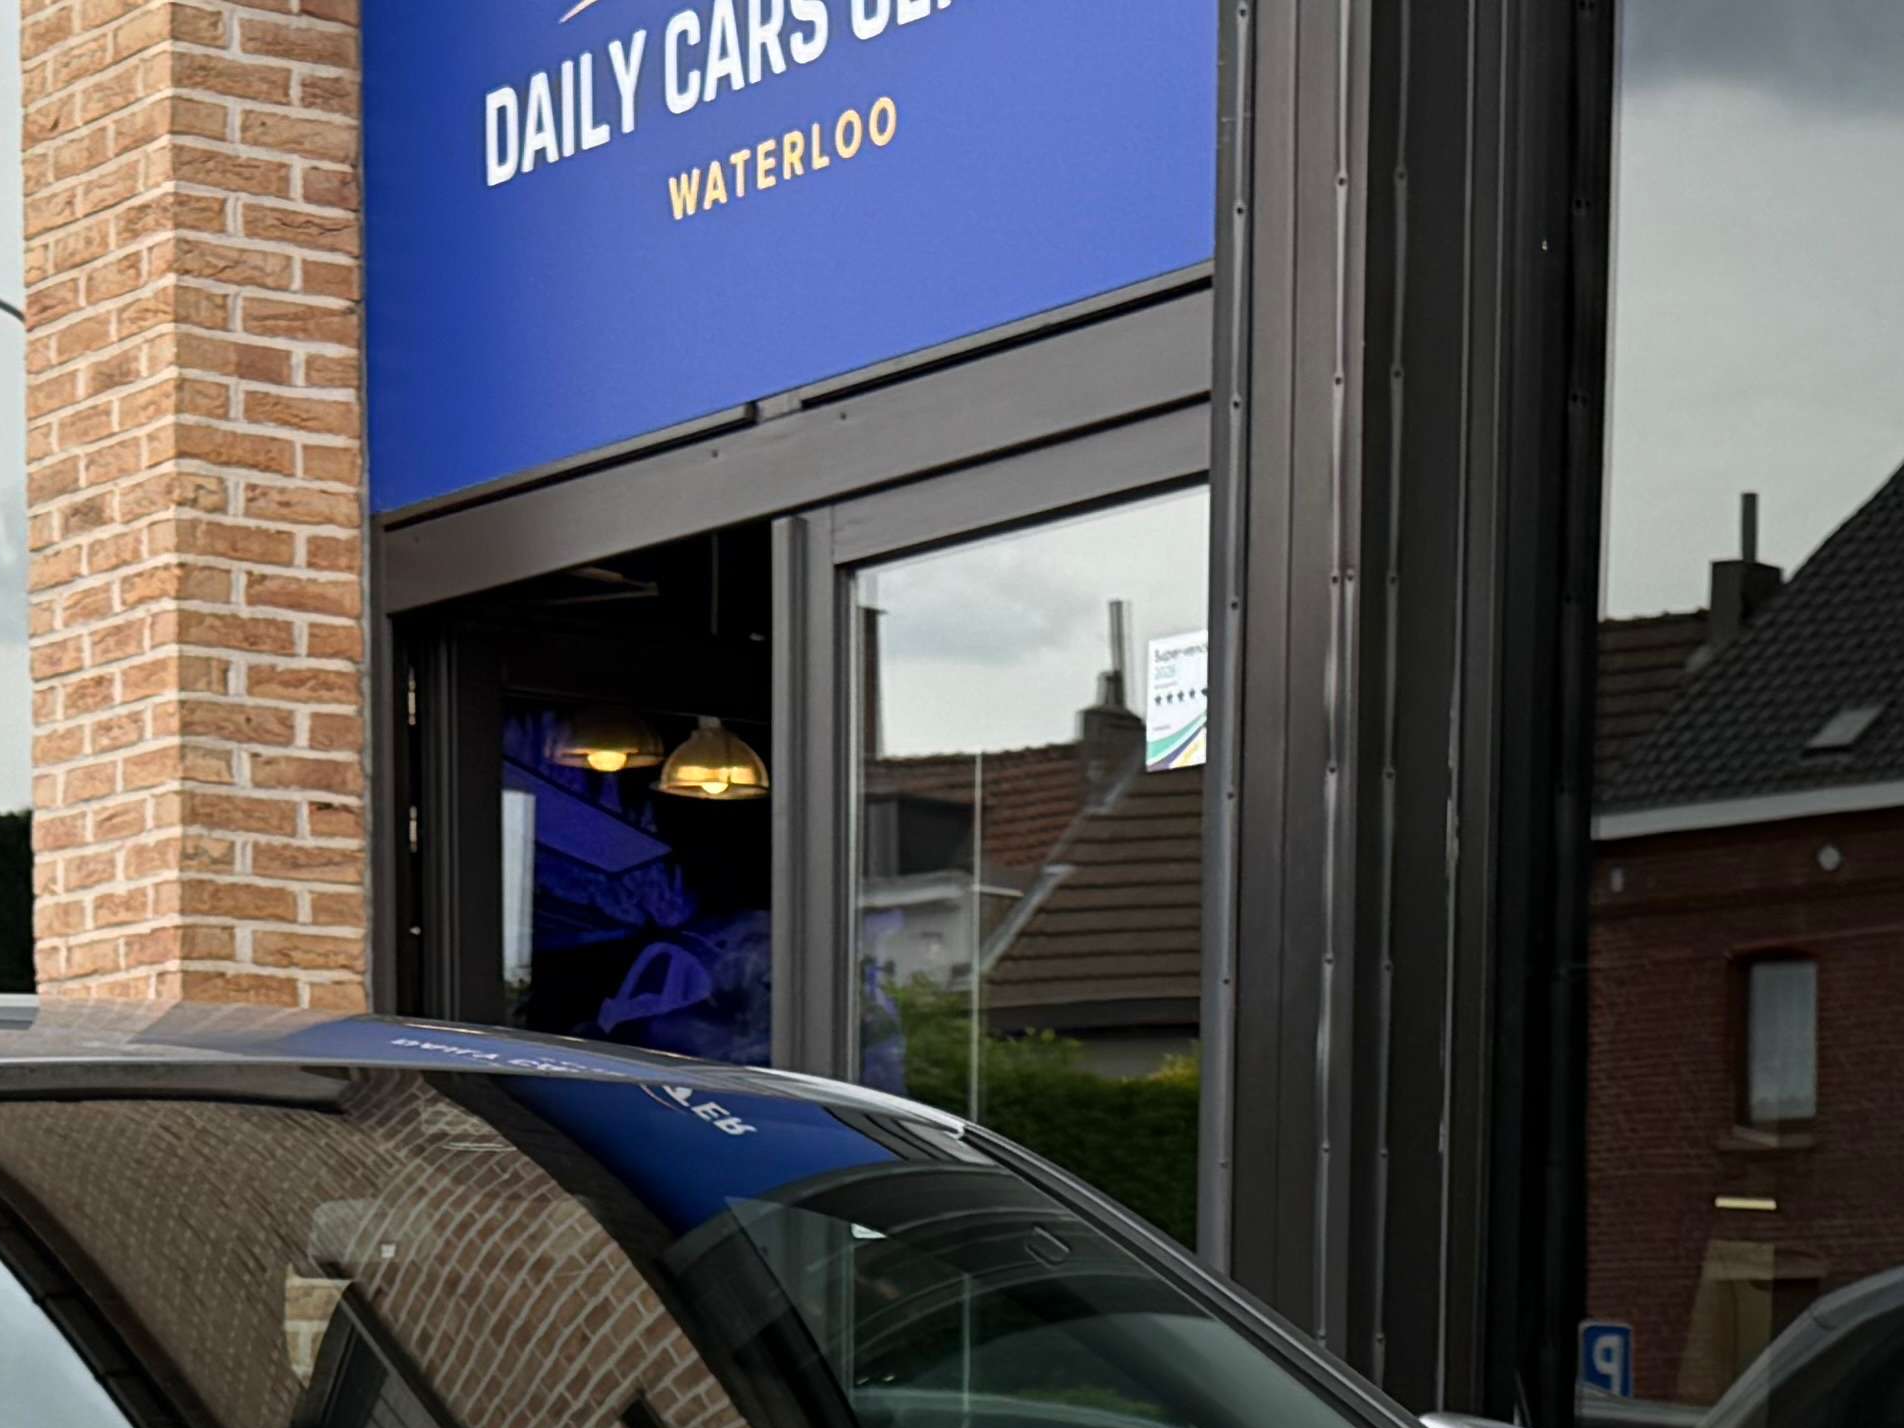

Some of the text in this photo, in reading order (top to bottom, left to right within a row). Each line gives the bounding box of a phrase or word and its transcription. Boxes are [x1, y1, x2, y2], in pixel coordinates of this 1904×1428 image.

[485, 0, 829, 187] DAILY CARS
[668, 97, 897, 220] WATERLOO
